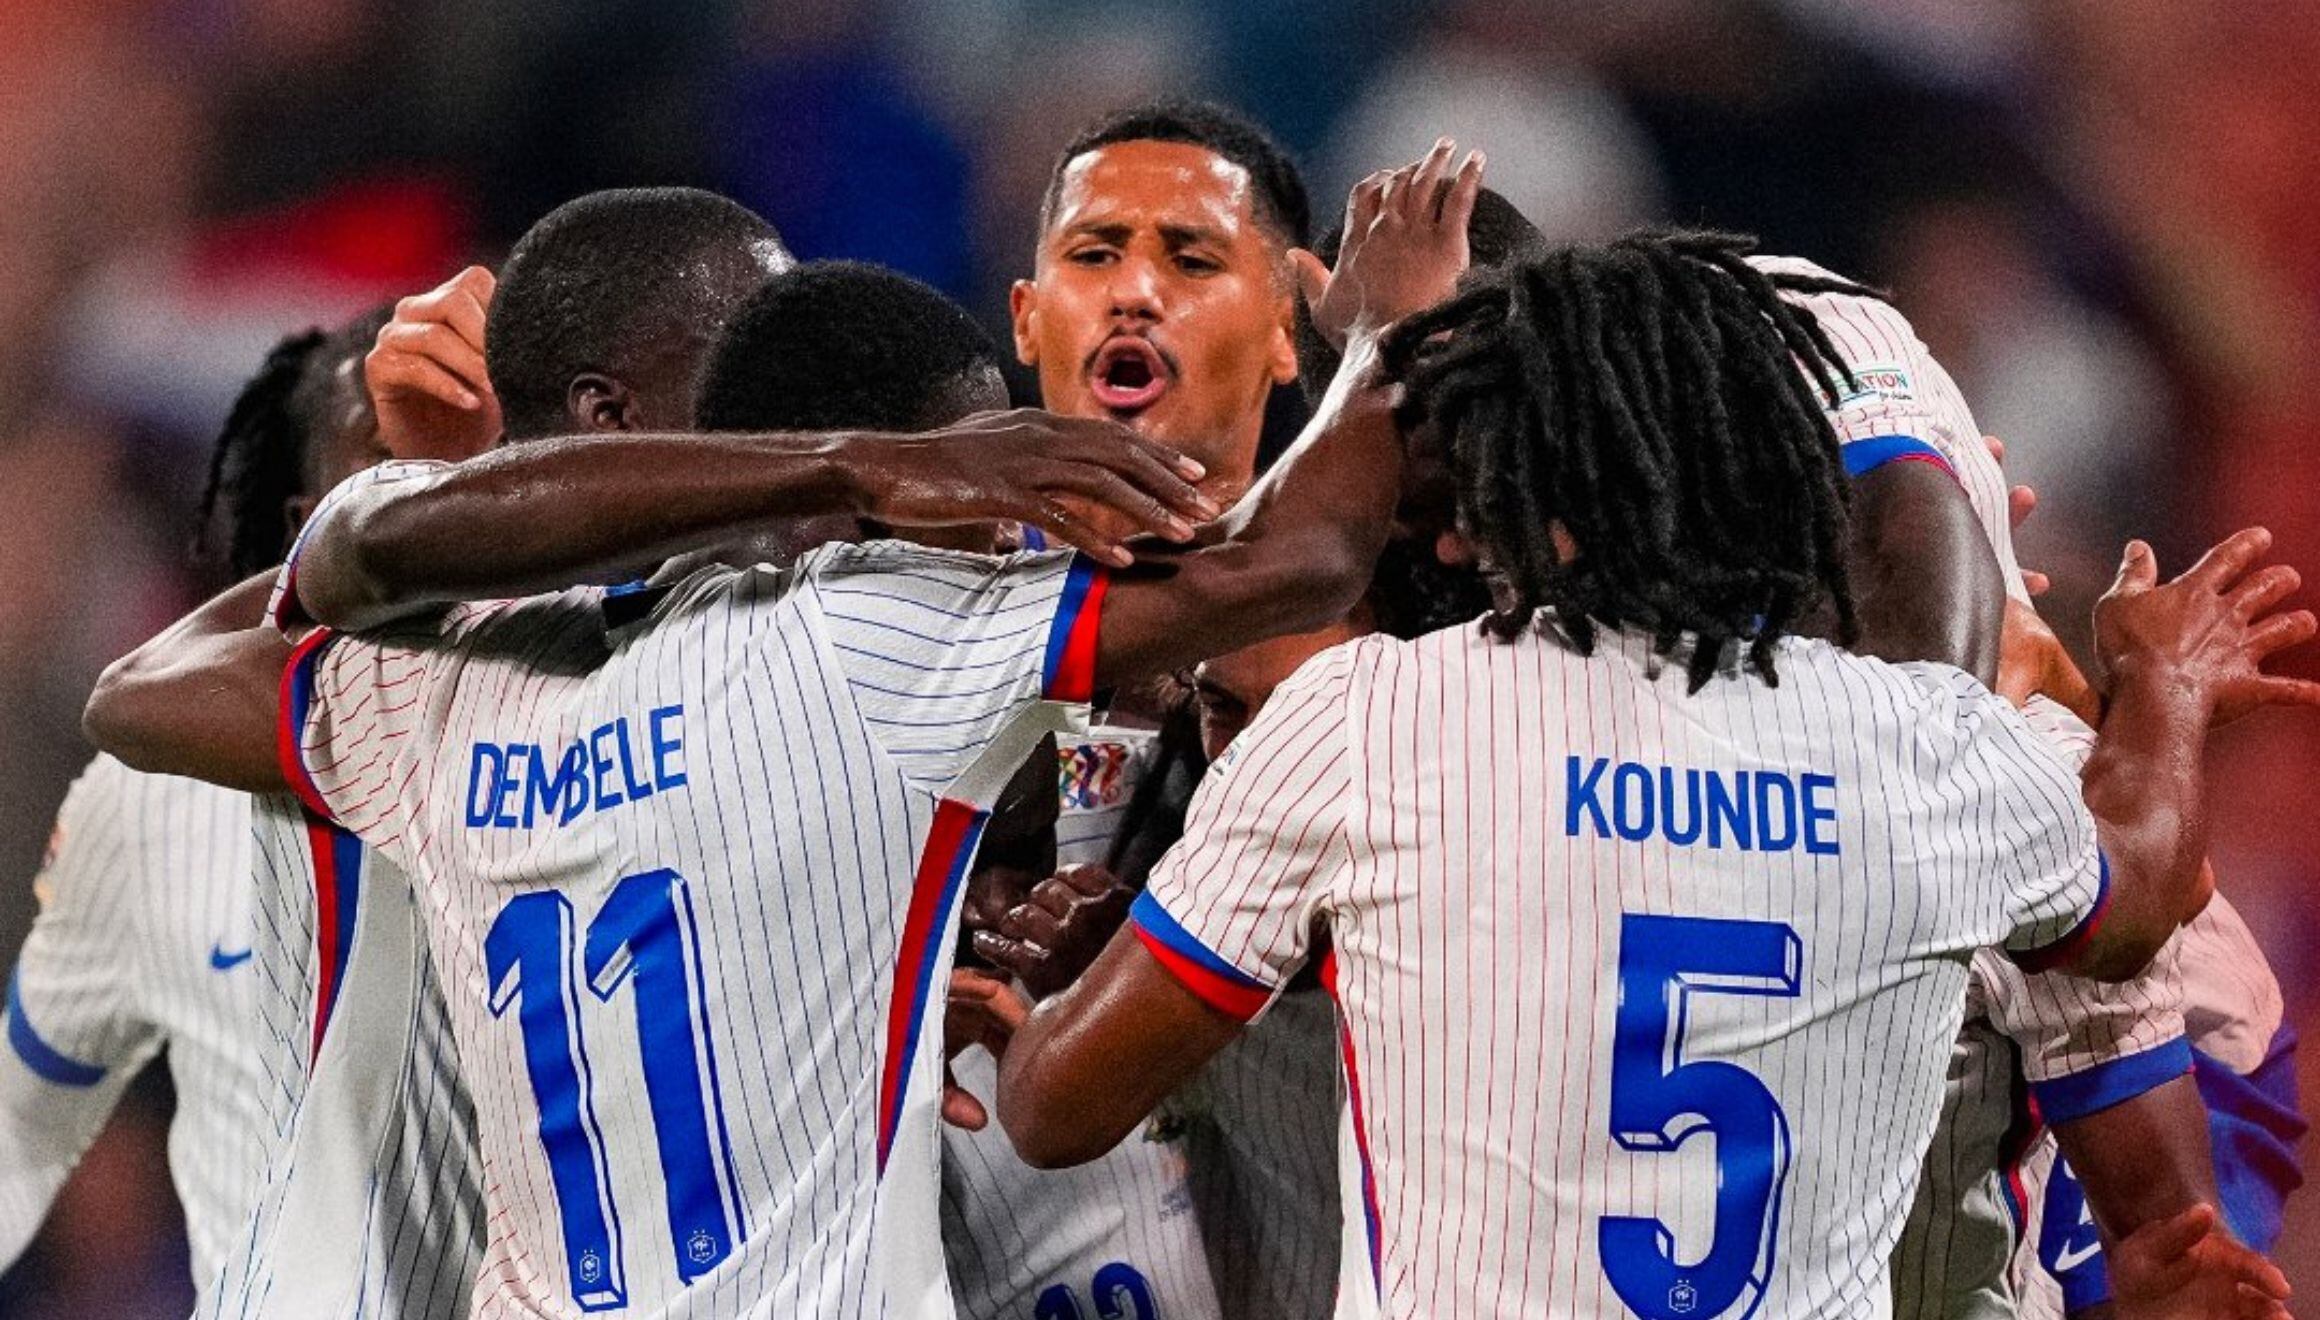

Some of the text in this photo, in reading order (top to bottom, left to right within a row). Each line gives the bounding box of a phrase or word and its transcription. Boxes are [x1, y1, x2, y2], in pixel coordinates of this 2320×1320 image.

[1856, 372, 1909, 390] ATION
[465, 703, 689, 829] DEMBELE
[1565, 756, 1841, 855] KOUNDE
[484, 867, 747, 1313] 11
[1599, 913, 1802, 1320] 5
